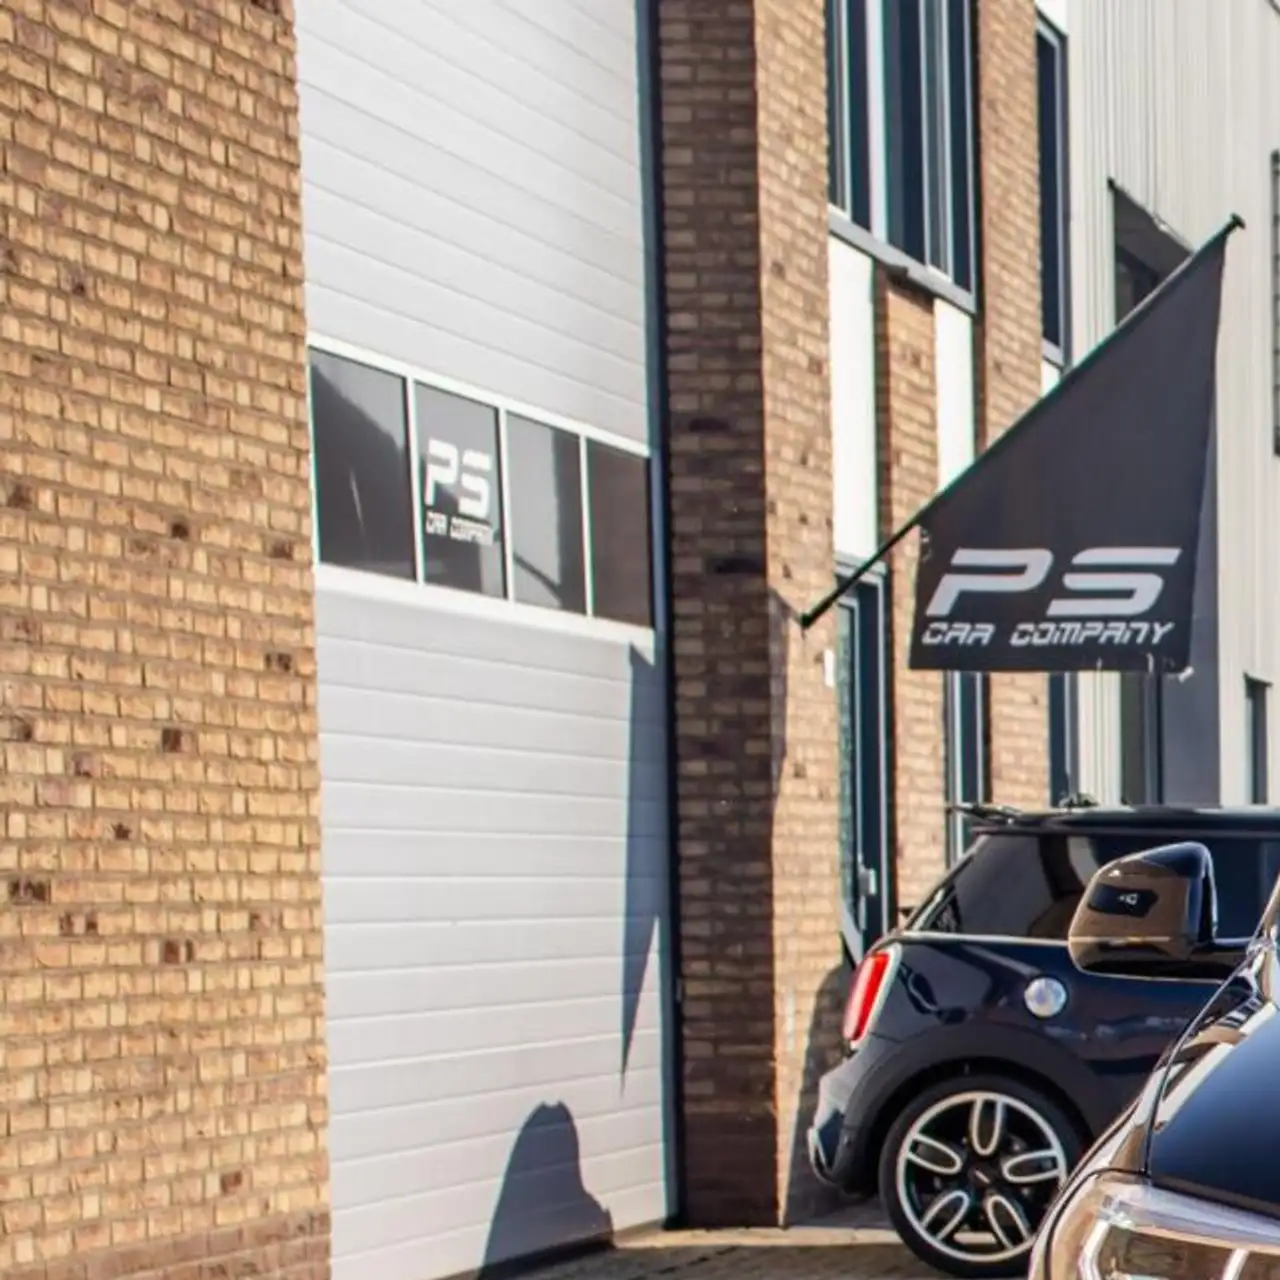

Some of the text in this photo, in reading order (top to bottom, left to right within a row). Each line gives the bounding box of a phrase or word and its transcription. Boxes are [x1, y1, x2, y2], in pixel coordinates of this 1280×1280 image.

[425, 437, 492, 518] PS
[925, 547, 1182, 617] PS
[921, 621, 1175, 646] CAR COMPANY
